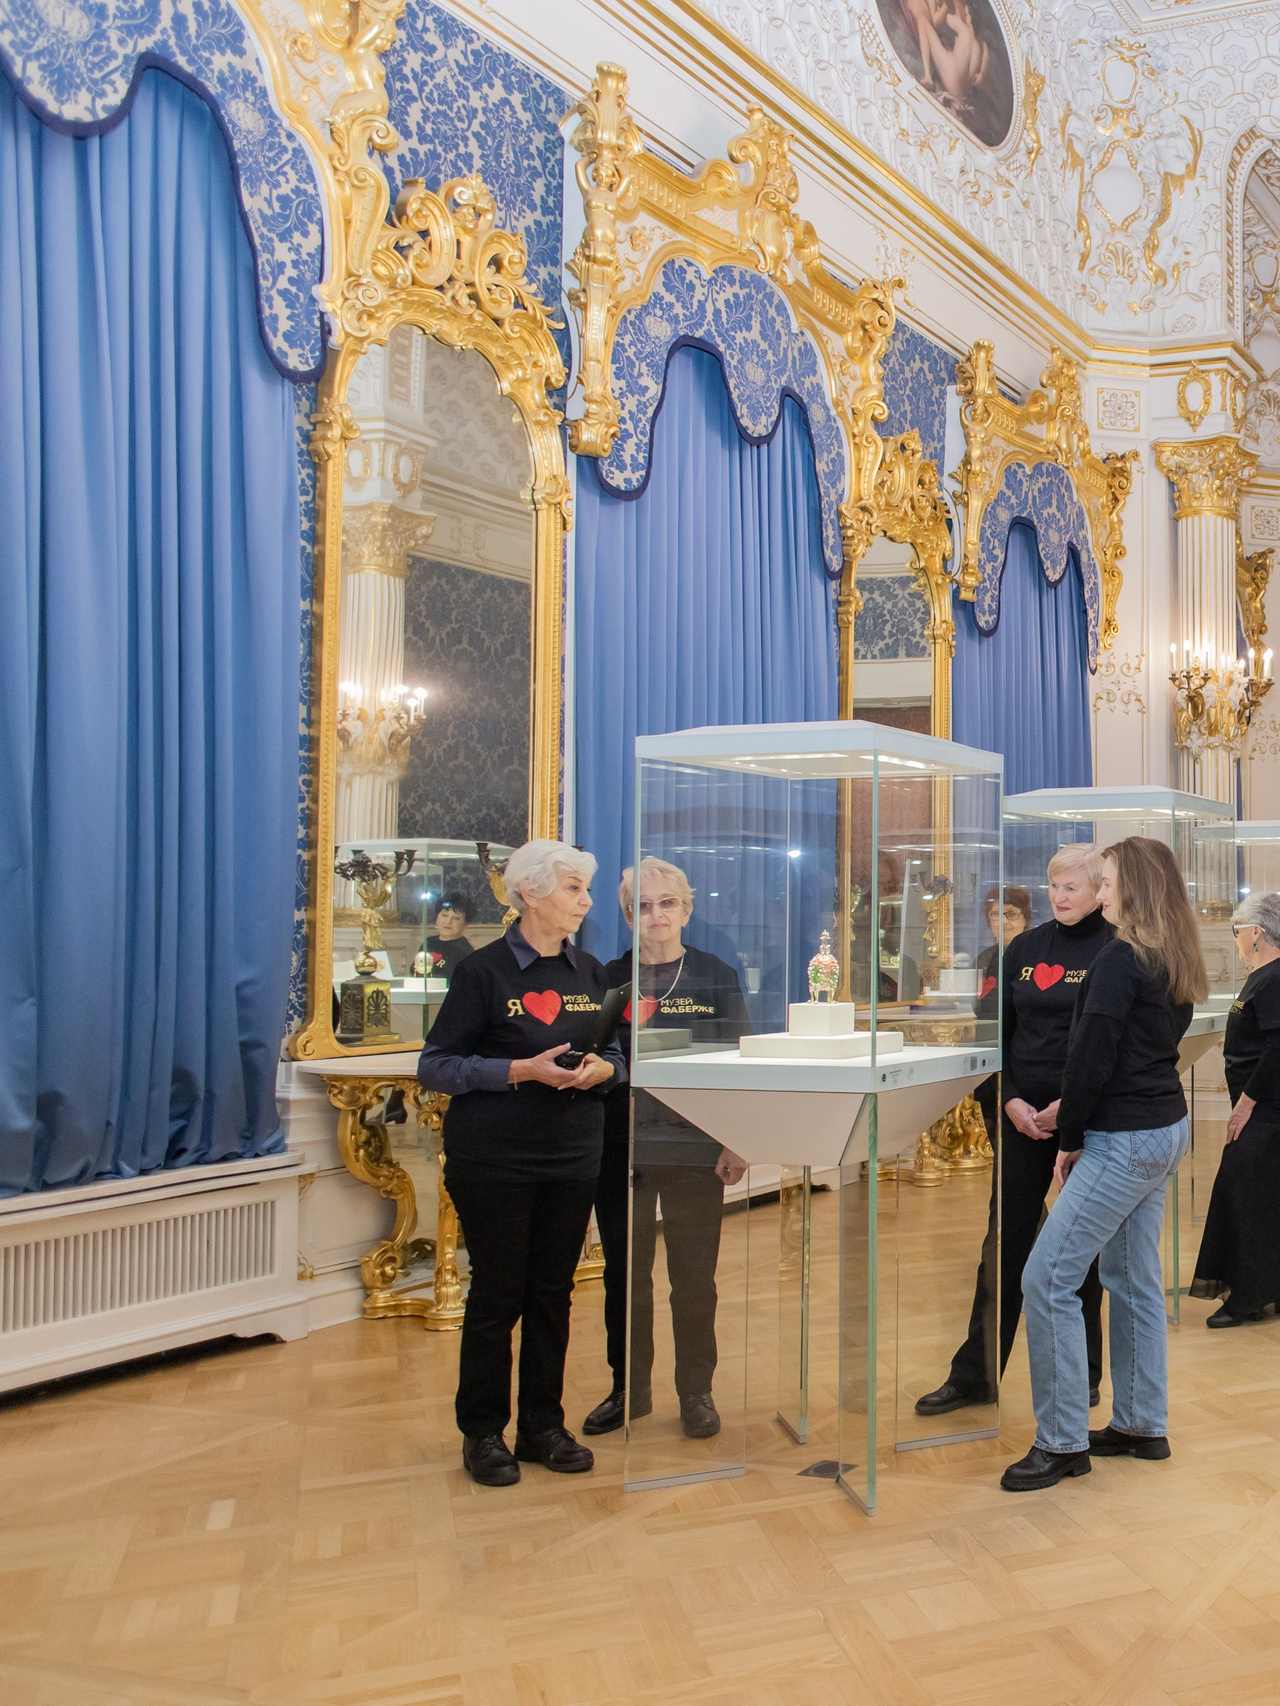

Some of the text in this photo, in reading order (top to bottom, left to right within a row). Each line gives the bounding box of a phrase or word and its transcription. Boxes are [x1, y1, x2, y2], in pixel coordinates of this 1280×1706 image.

[1019, 966, 1034, 981] Я
[507, 994, 590, 1017] Я МУЗЕЙ
[660, 997, 693, 1006] МУЗЕЙ
[660, 1005, 715, 1014] ФАБЕРЖЕ
